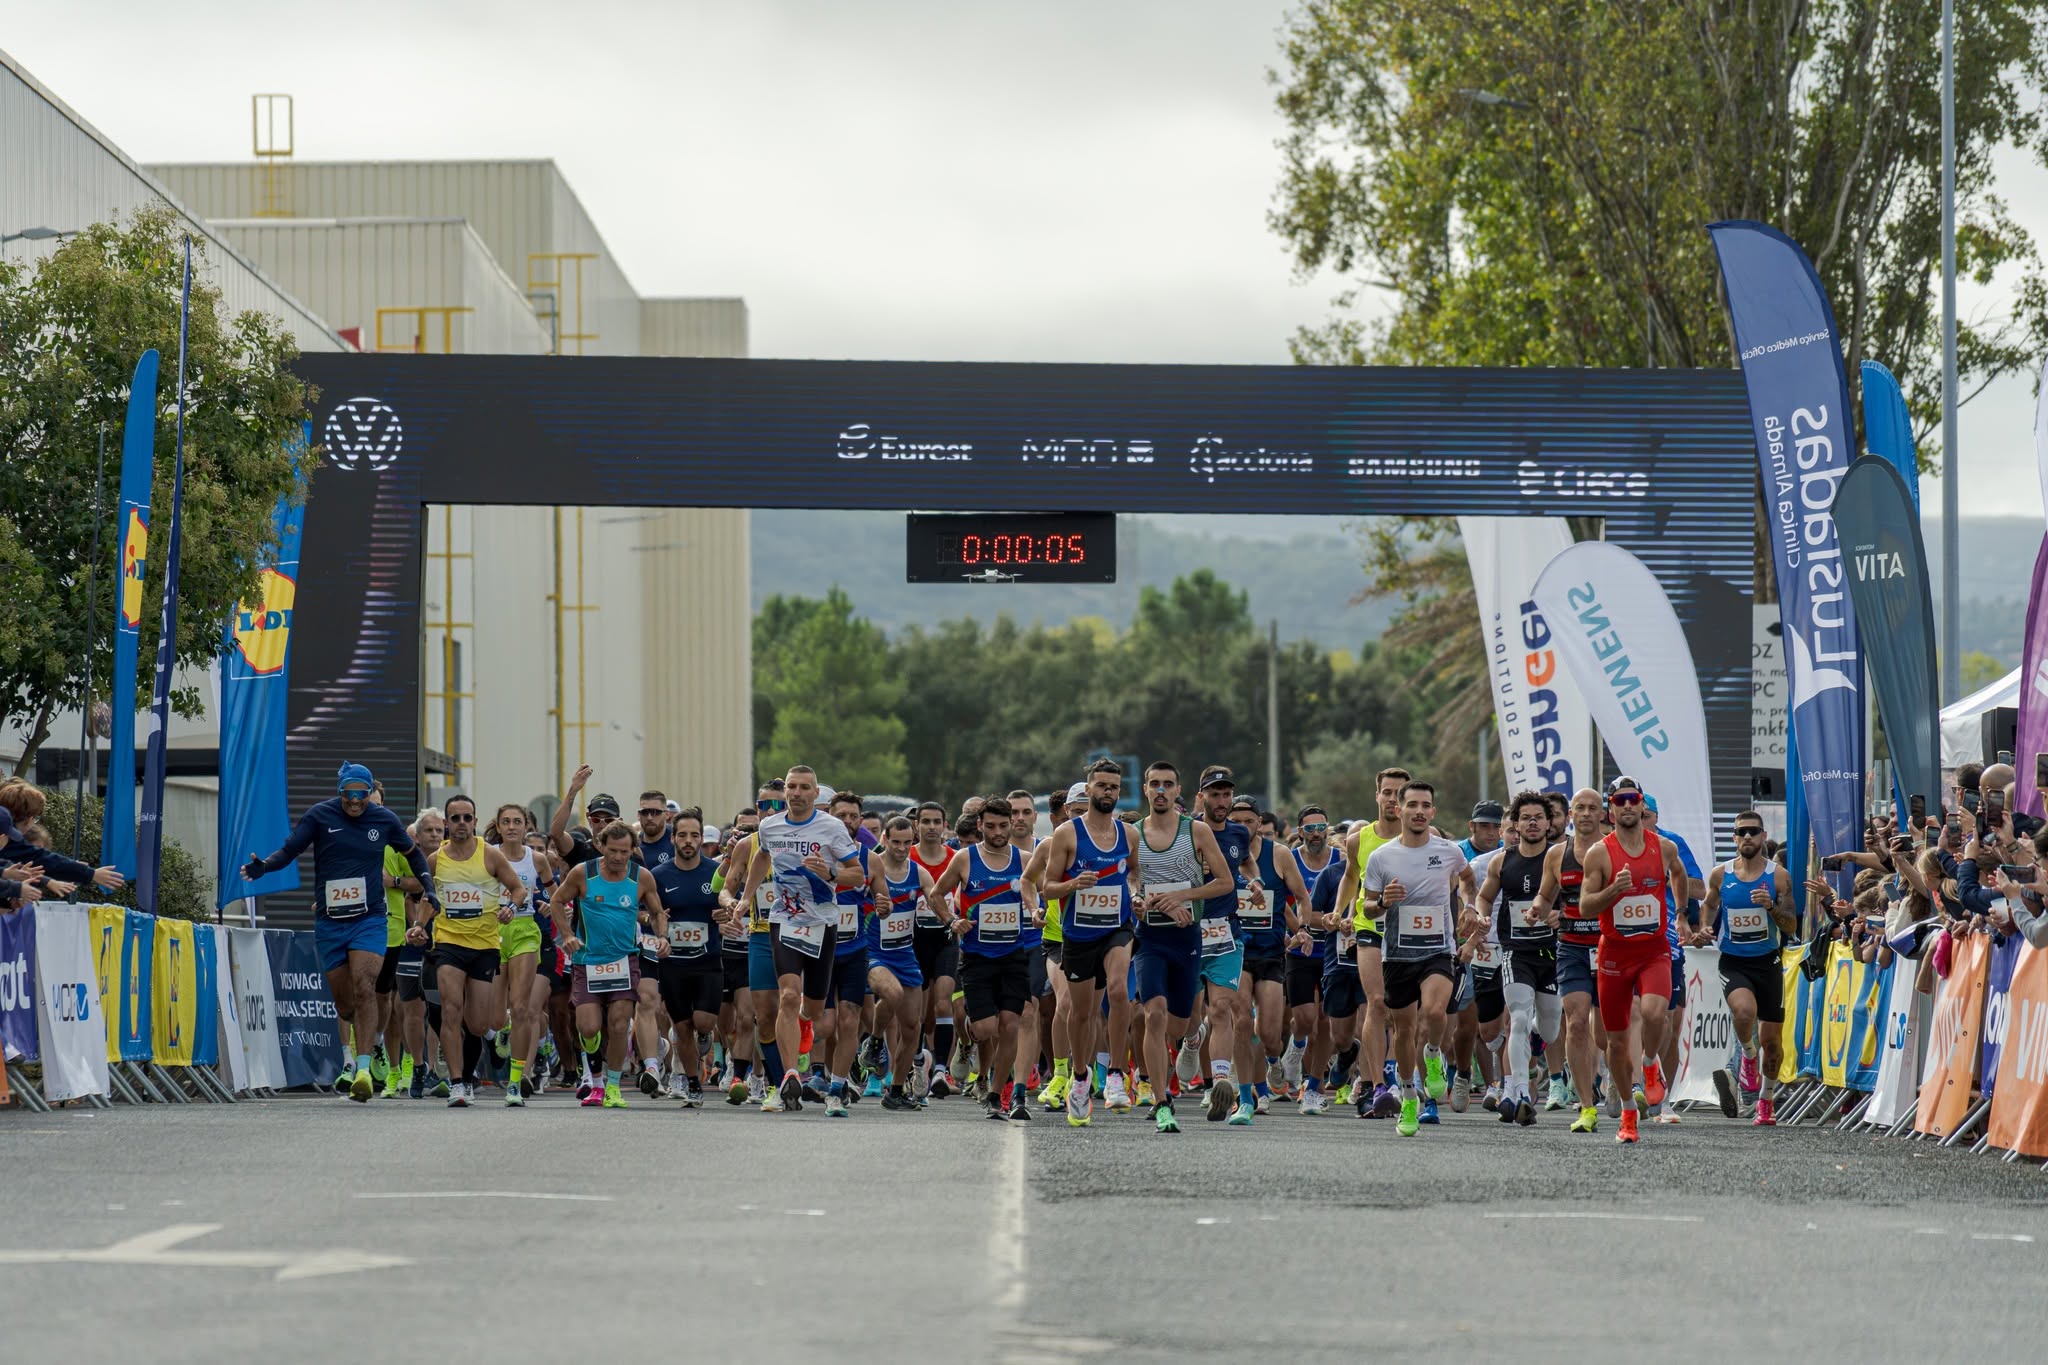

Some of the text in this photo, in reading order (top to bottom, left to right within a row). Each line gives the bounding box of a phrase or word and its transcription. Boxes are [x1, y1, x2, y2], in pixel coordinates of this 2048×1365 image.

[961, 534, 1086, 564] 0:00:05
[1855, 551, 1906, 582] VITA
[332, 886, 361, 901] 243
[446, 890, 481, 903] 1294
[1080, 893, 1119, 908] 1795
[984, 911, 1017, 924] 2318
[1623, 905, 1652, 919] 861
[888, 918, 911, 933] 583
[1413, 916, 1433, 929] 53
[1733, 915, 1762, 928] 830
[675, 930, 702, 943] 195
[594, 962, 622, 975] 961
